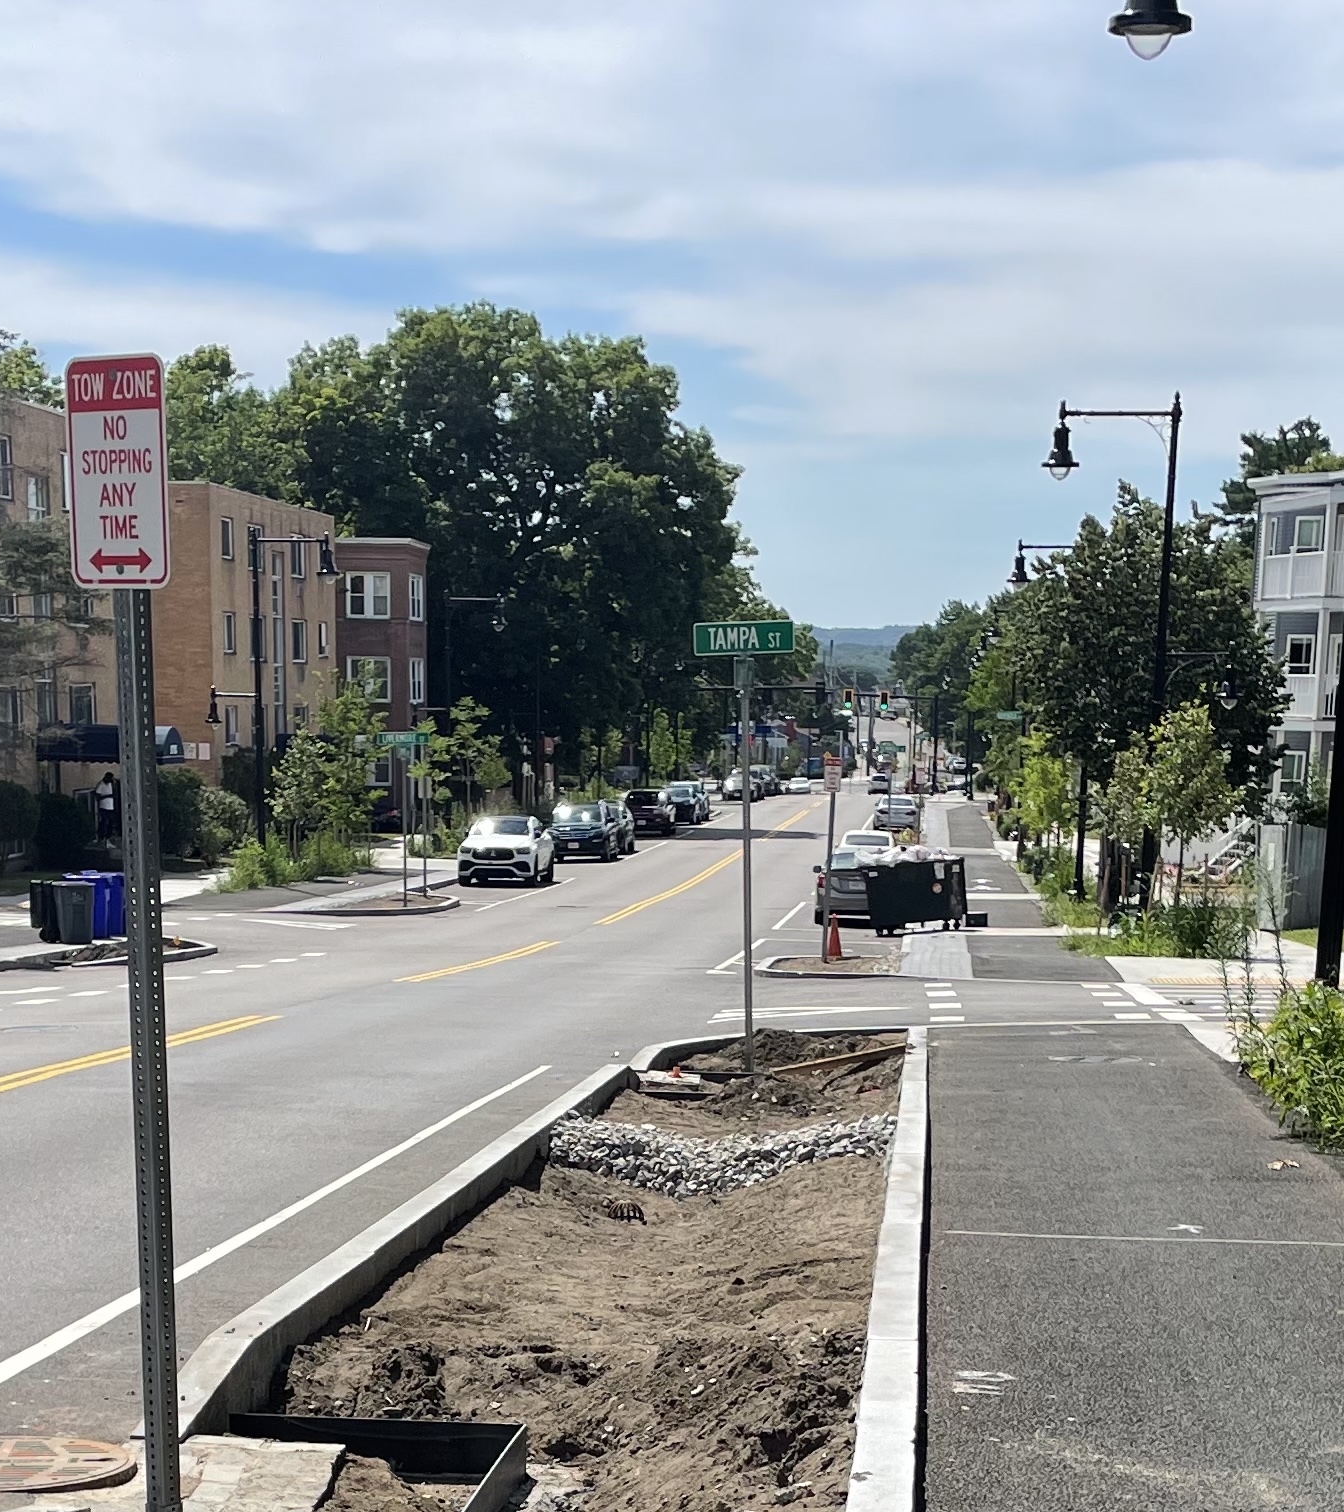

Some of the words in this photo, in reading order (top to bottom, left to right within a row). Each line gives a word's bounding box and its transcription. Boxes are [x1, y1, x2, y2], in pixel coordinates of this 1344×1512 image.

[71, 373, 104, 402] TOW
[112, 369, 156, 400] ZONE
[103, 415, 127, 441] NO
[82, 448, 152, 475] STOPPING
[99, 482, 137, 507] ANY
[99, 515, 139, 540] TIME
[707, 626, 760, 650] TAMPA
[767, 632, 782, 648] ST
